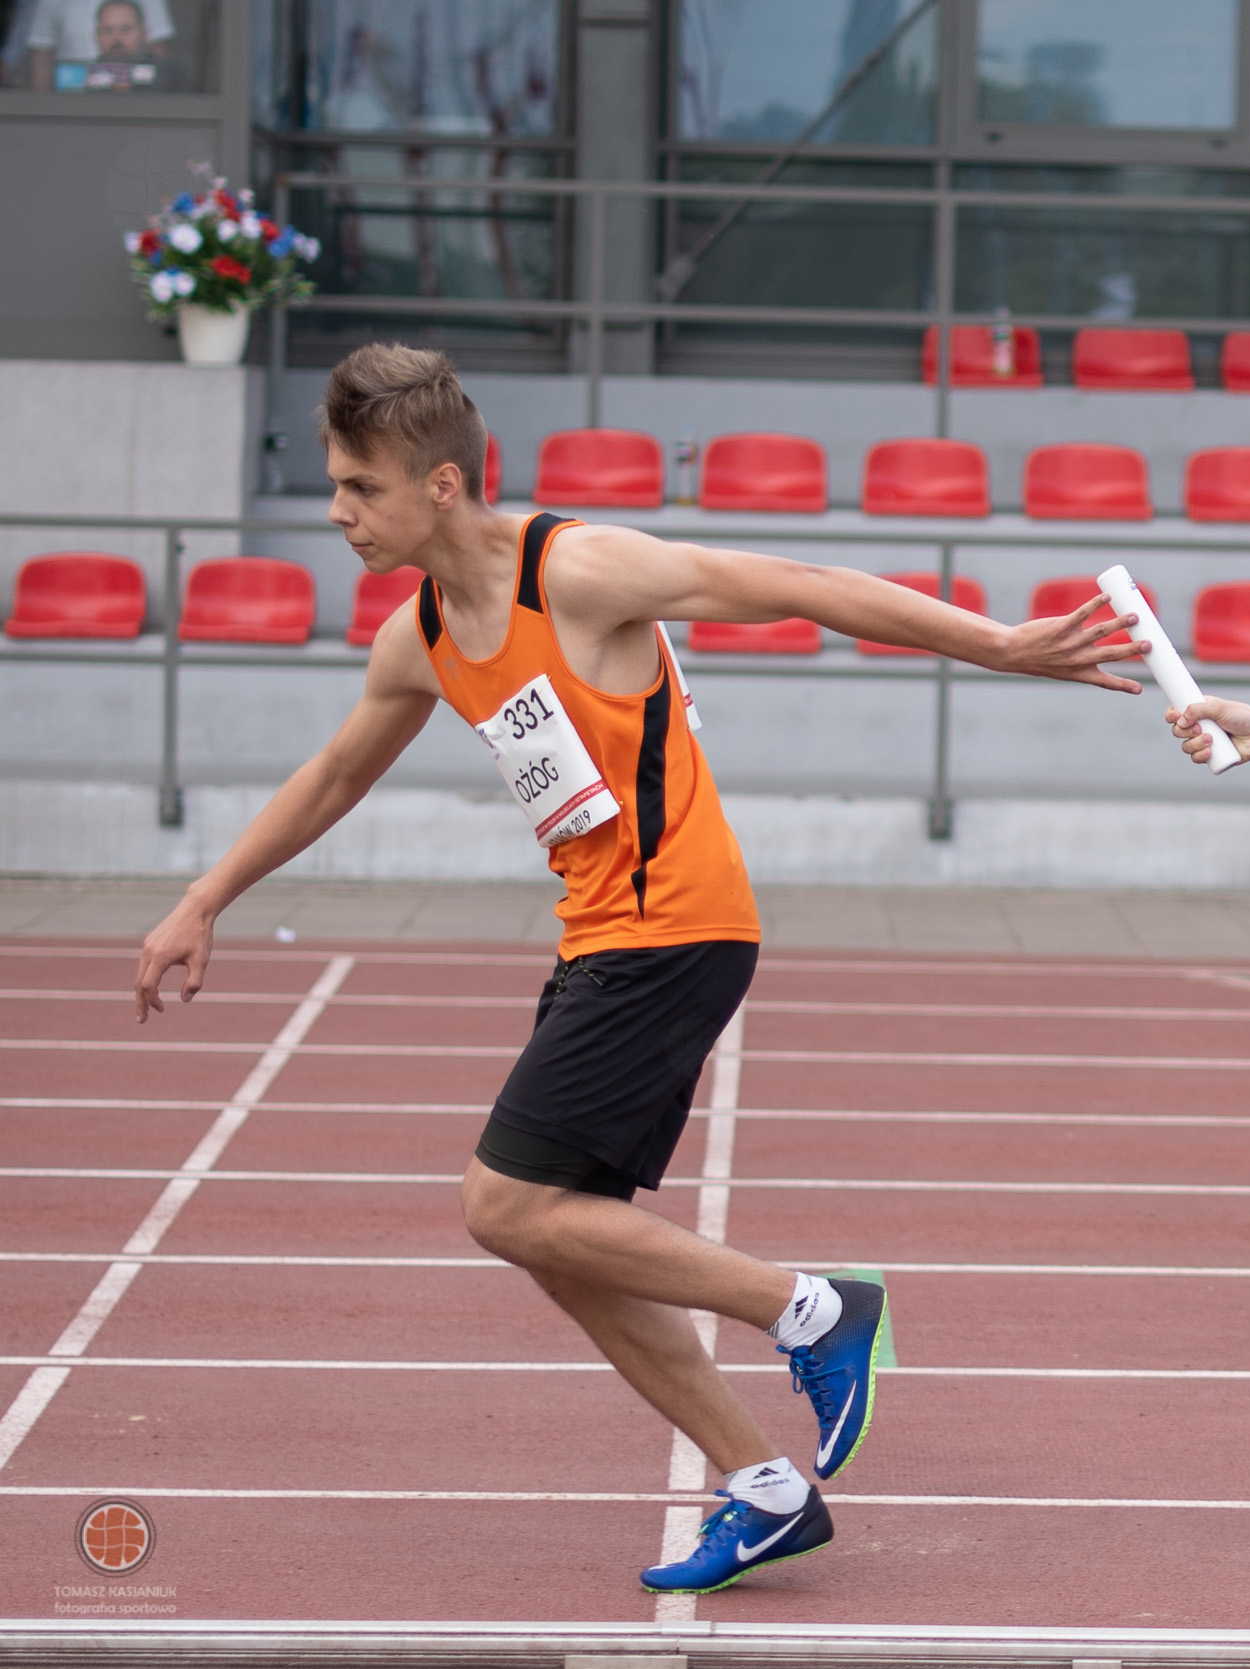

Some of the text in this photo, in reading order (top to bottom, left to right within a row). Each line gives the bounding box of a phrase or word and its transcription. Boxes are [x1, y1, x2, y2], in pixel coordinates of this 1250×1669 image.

[504, 688, 555, 740] 331
[515, 757, 559, 803] OŻÓG
[571, 810, 591, 834] 2019
[800, 1292, 820, 1327] adidas
[750, 1478, 790, 1489] adidas
